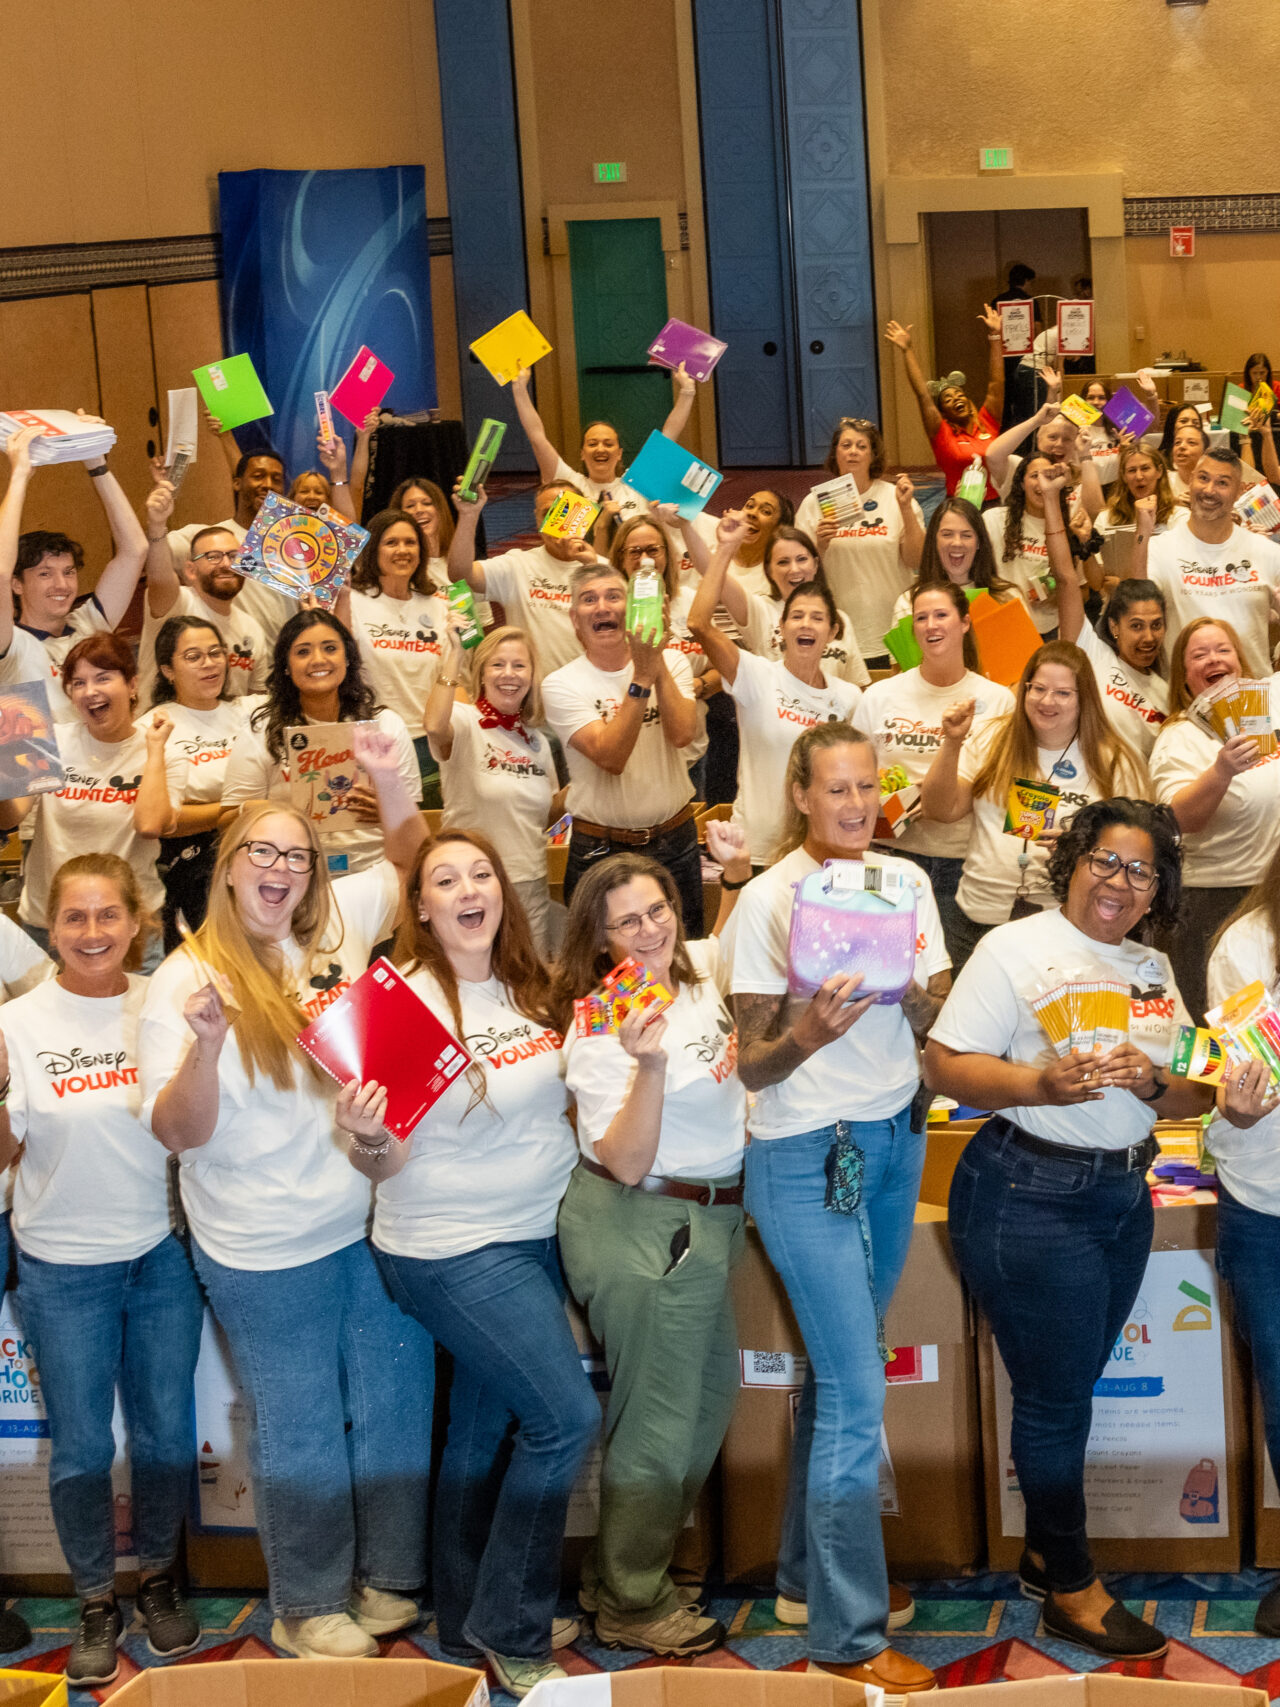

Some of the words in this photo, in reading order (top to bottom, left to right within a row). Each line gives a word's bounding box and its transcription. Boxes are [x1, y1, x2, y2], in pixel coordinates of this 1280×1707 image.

[985, 149, 1007, 168] EXIT
[599, 163, 620, 181] EXIT
[834, 526, 888, 538] LUNTEARS
[1181, 570, 1259, 588] VOLUNTES
[529, 588, 571, 603] VOLUNT
[777, 707, 823, 728] VOLUN
[894, 734, 940, 748] VOLUN
[64, 767, 101, 788] isney
[50, 787, 139, 804] OLUNTEAR
[464, 1023, 532, 1056] Disney
[486, 1029, 563, 1070] VOLUNTE
[36, 1047, 126, 1076] Disney
[51, 1067, 139, 1098] VOLUNT
[2, 1338, 33, 1359] CK
[8, 1359, 24, 1369] TO
[0, 1390, 40, 1403] RIVE
